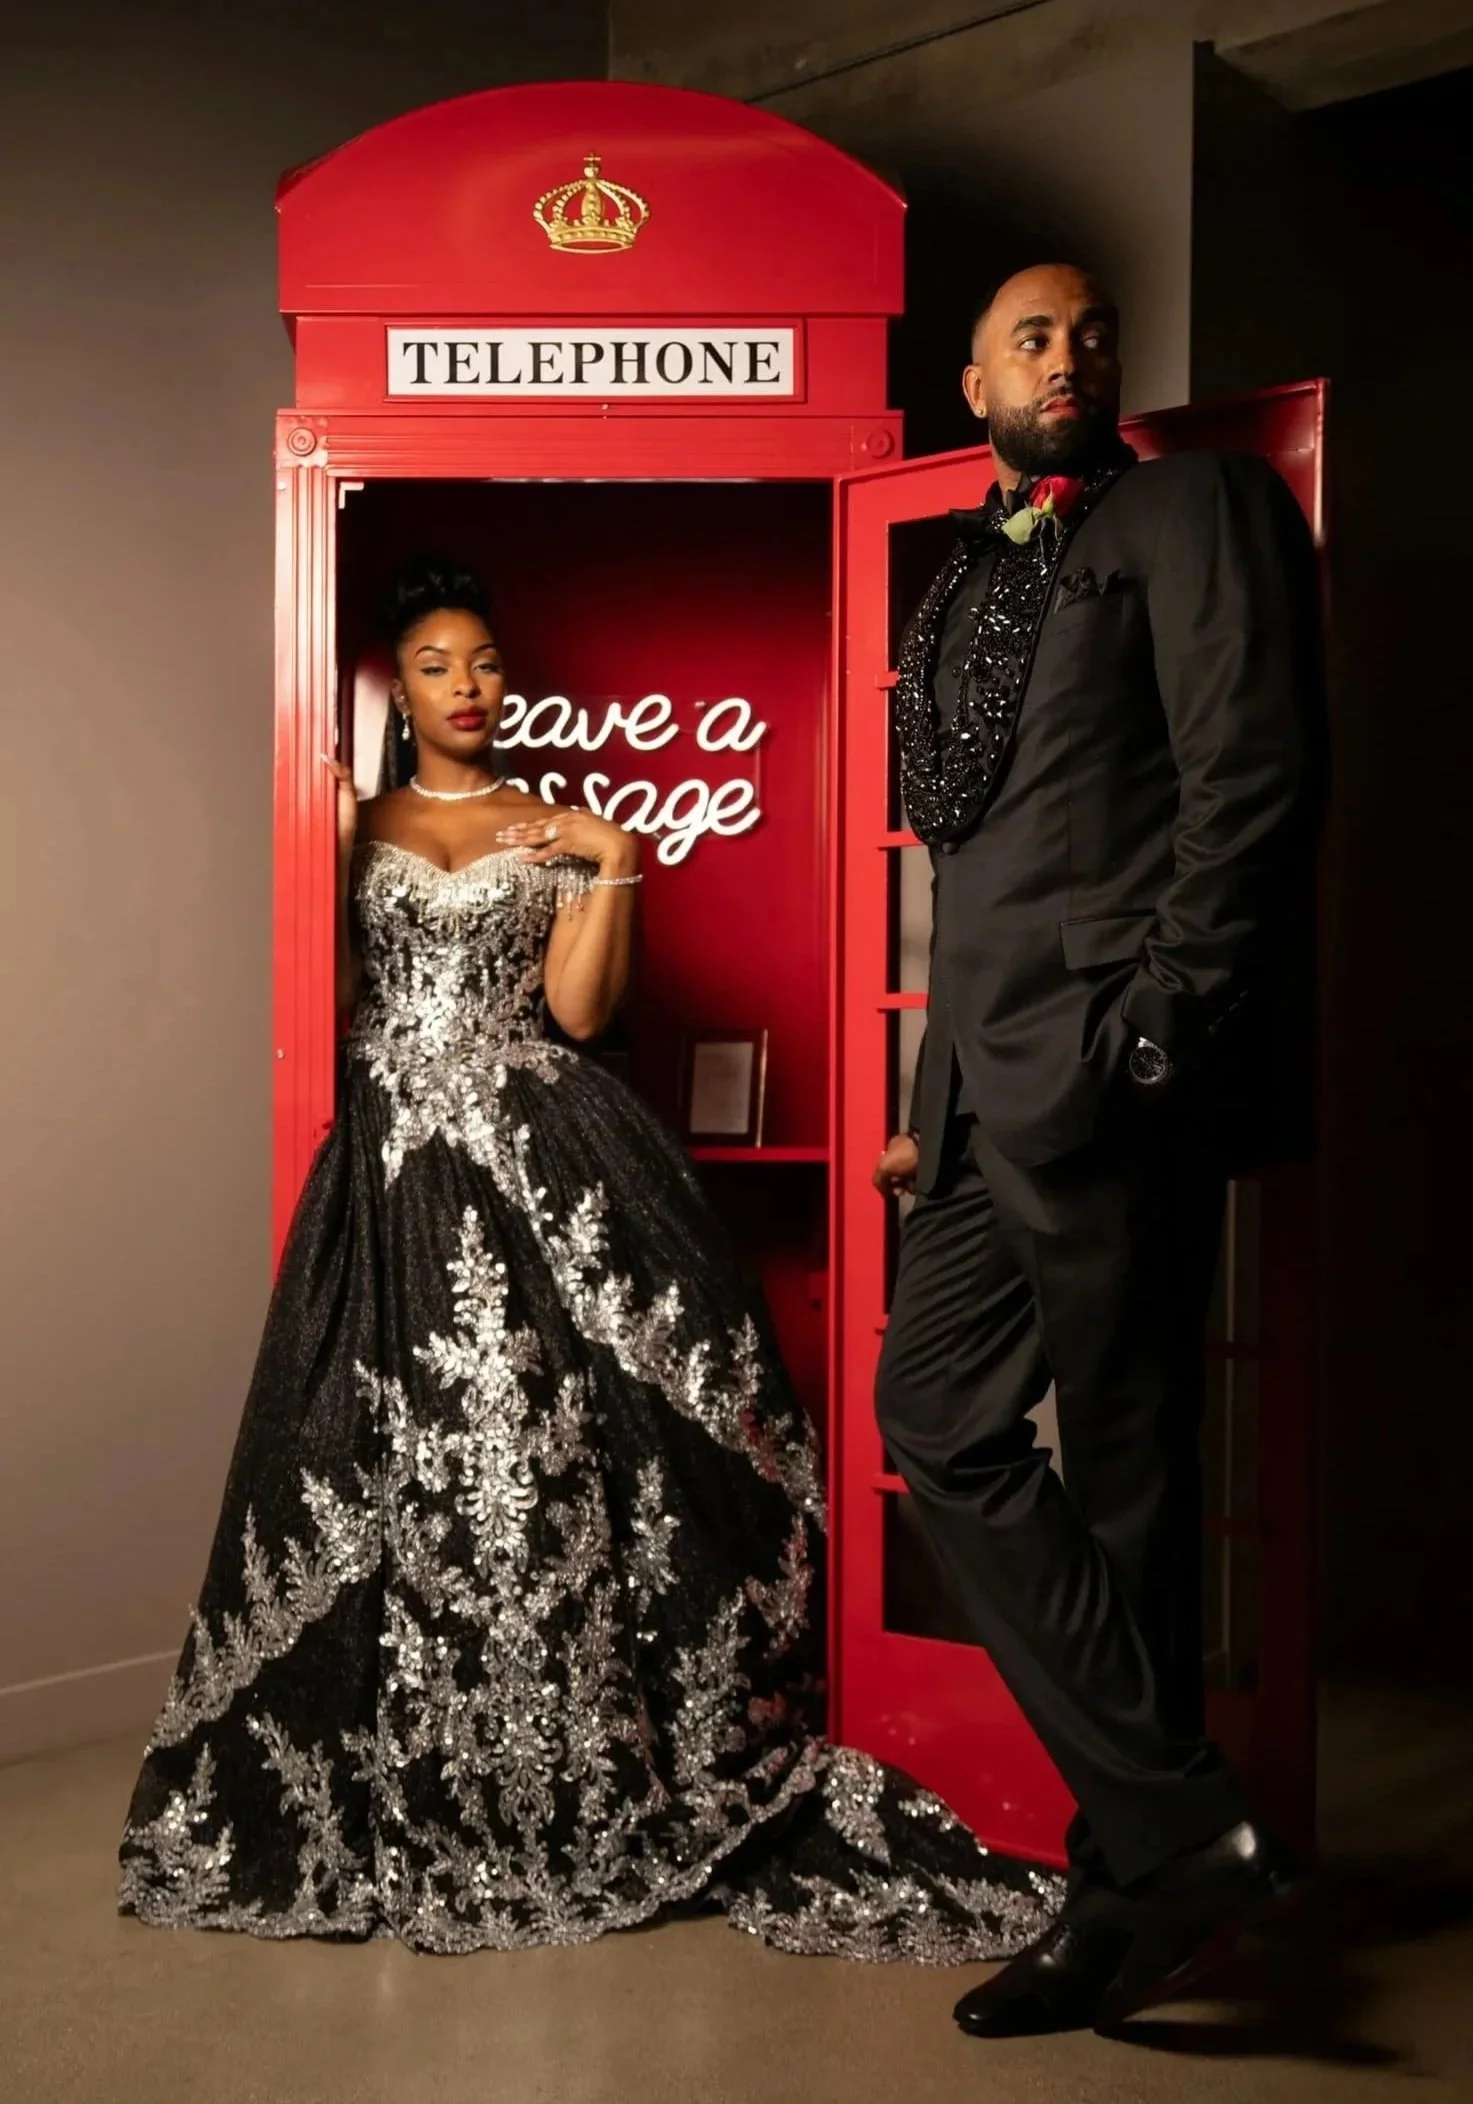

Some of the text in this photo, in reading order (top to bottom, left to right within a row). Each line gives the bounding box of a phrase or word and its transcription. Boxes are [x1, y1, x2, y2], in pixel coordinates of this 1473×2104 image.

[403, 341, 781, 384] TELEPHONE
[493, 694, 767, 751] eave a
[505, 772, 761, 866] ssage
